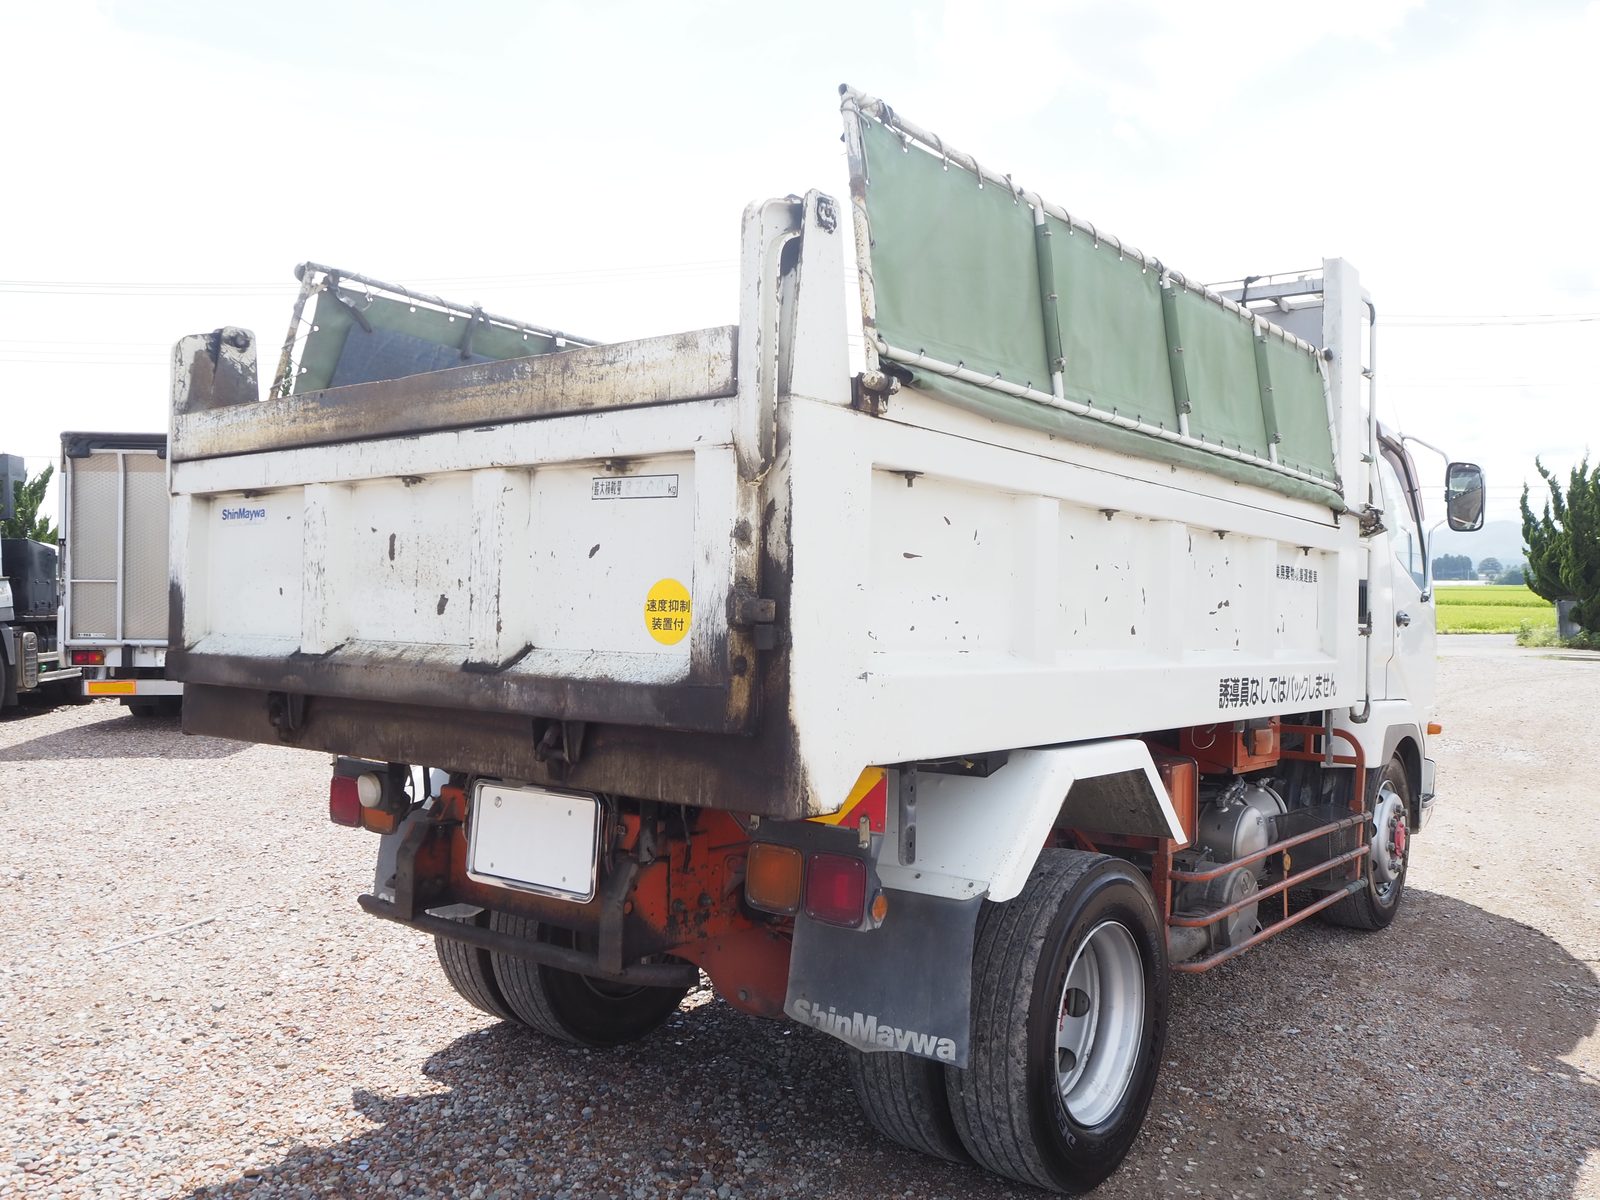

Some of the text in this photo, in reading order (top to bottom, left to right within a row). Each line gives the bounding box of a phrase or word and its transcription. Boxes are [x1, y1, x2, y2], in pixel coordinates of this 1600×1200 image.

[667, 483, 677, 495] kg
[221, 507, 266, 521] ShinMaywa
[646, 598, 691, 613] 速度抑制
[651, 616, 685, 632] 装置付
[1218, 672, 1338, 709] 誘導員なしではバックしません
